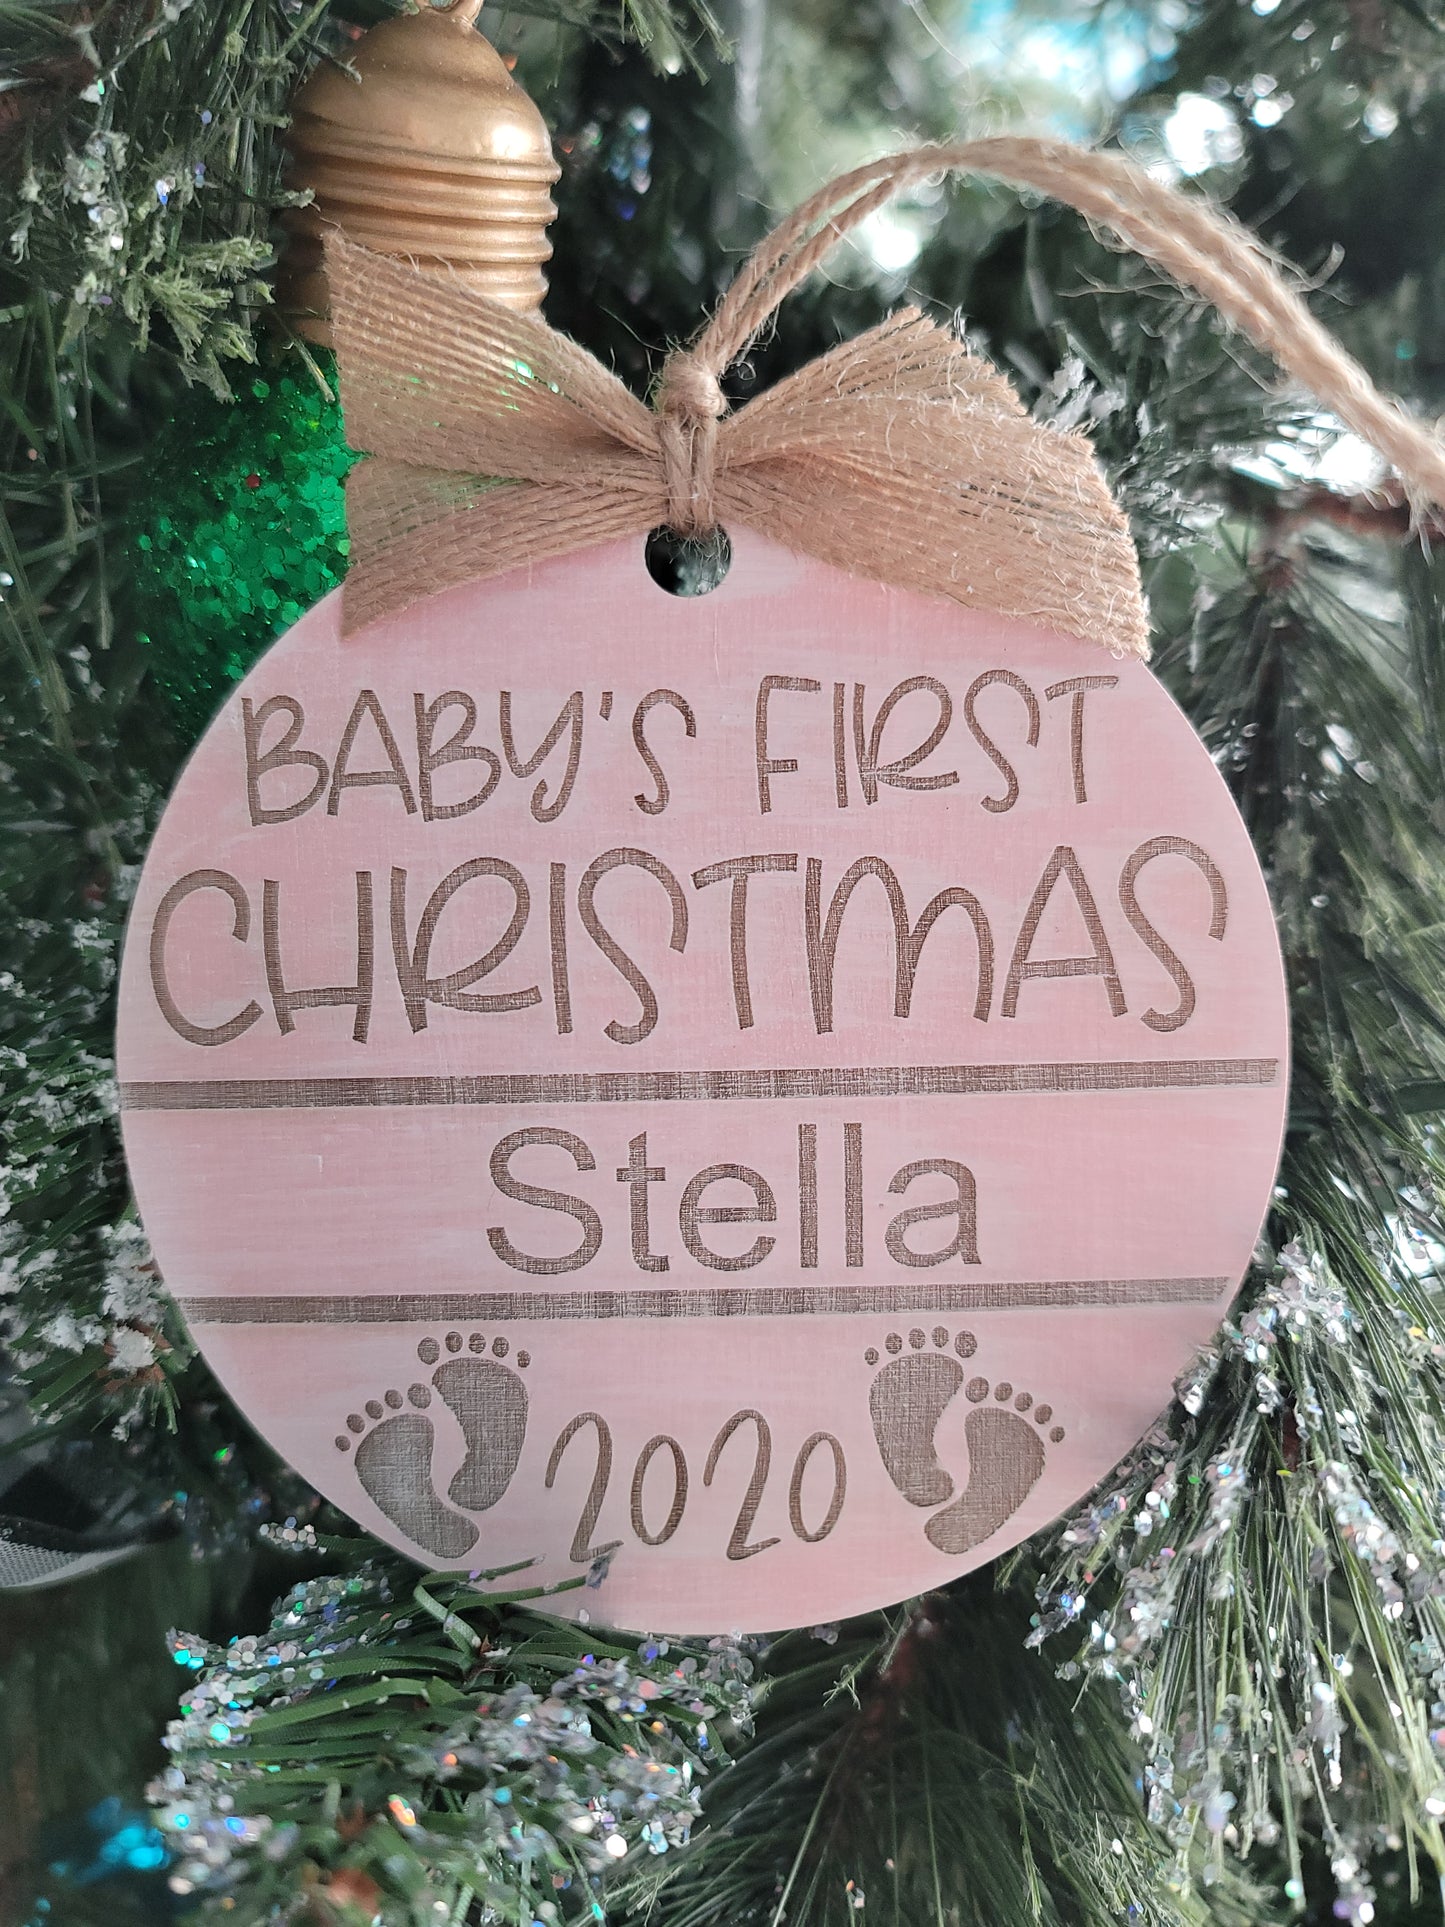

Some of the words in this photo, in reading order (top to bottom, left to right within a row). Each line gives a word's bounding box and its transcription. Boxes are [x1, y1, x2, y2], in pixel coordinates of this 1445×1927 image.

[241, 688, 697, 826] BABY'S
[756, 669, 1120, 815] FIRST
[150, 835, 1229, 1046] CHRISTMAS
[486, 1122, 982, 1275] Stella
[545, 1409, 847, 1563] 2020
